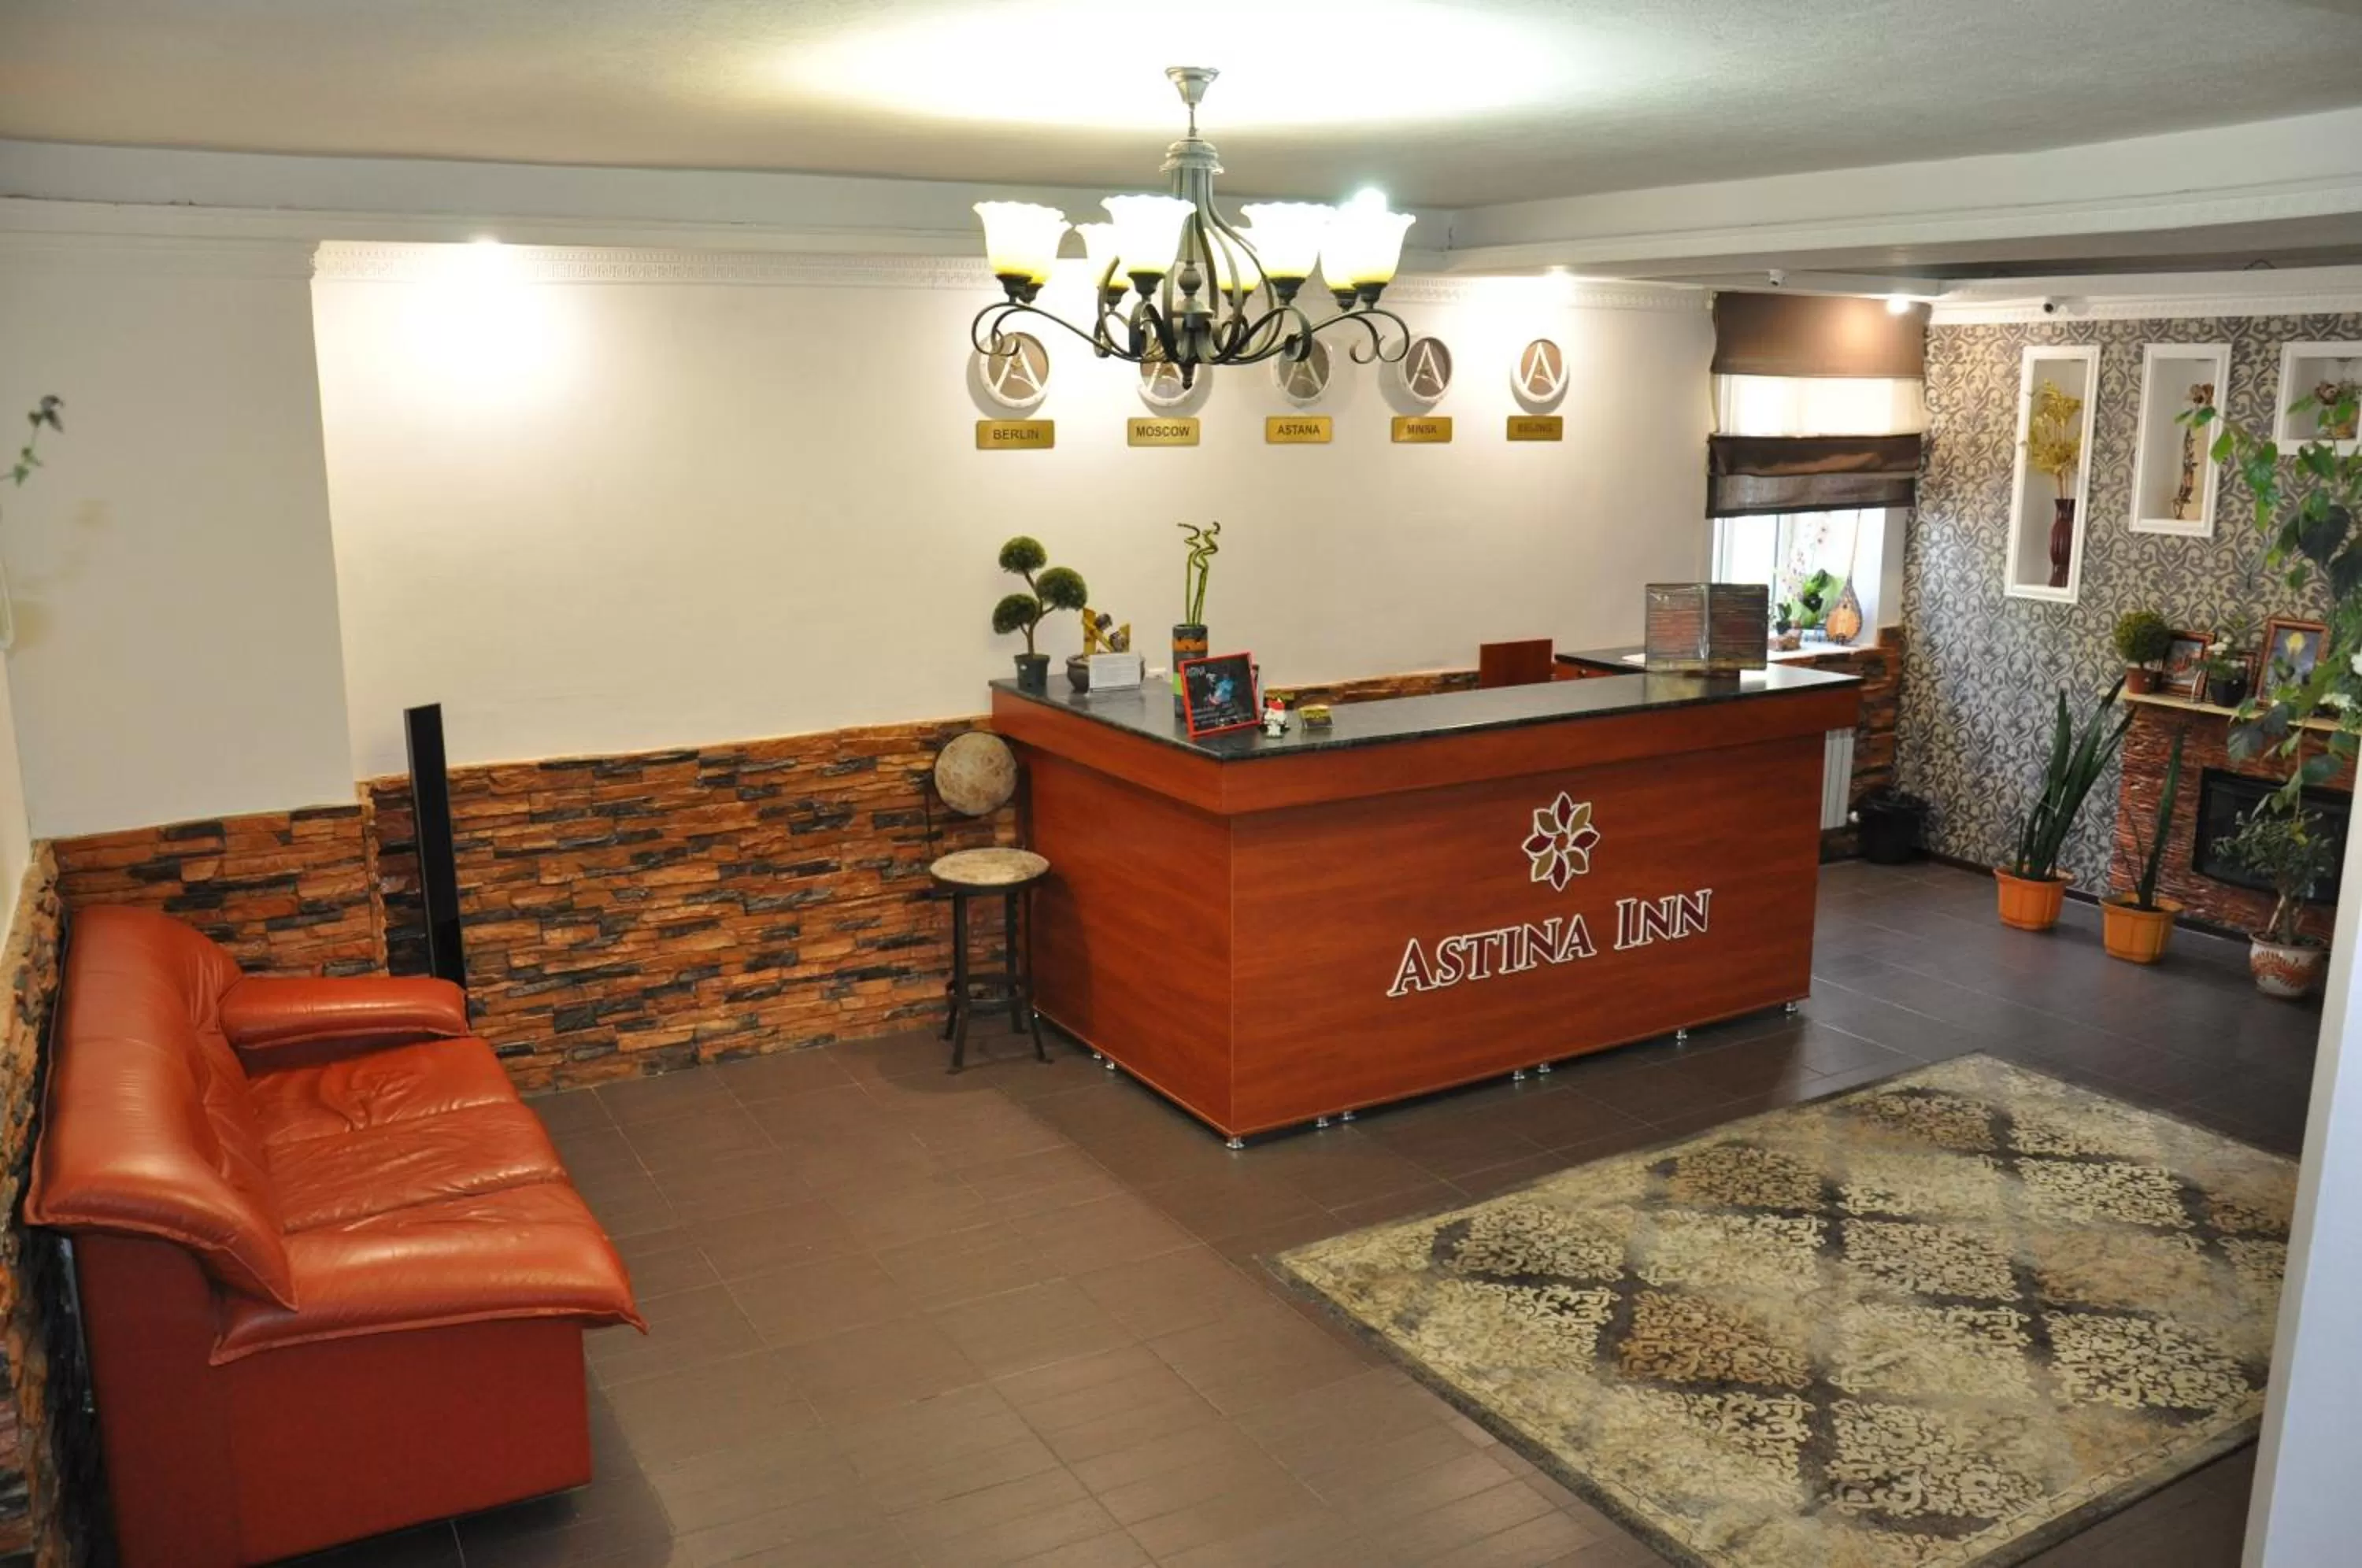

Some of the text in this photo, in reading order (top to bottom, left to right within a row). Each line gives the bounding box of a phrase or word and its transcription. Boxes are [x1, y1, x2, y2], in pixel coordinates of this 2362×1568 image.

[993, 428, 1039, 440] BERLIN
[1136, 426, 1190, 437] MOSCOW
[1278, 423, 1320, 435] ASTANA
[1386, 889, 1712, 997] ASTINA INN
